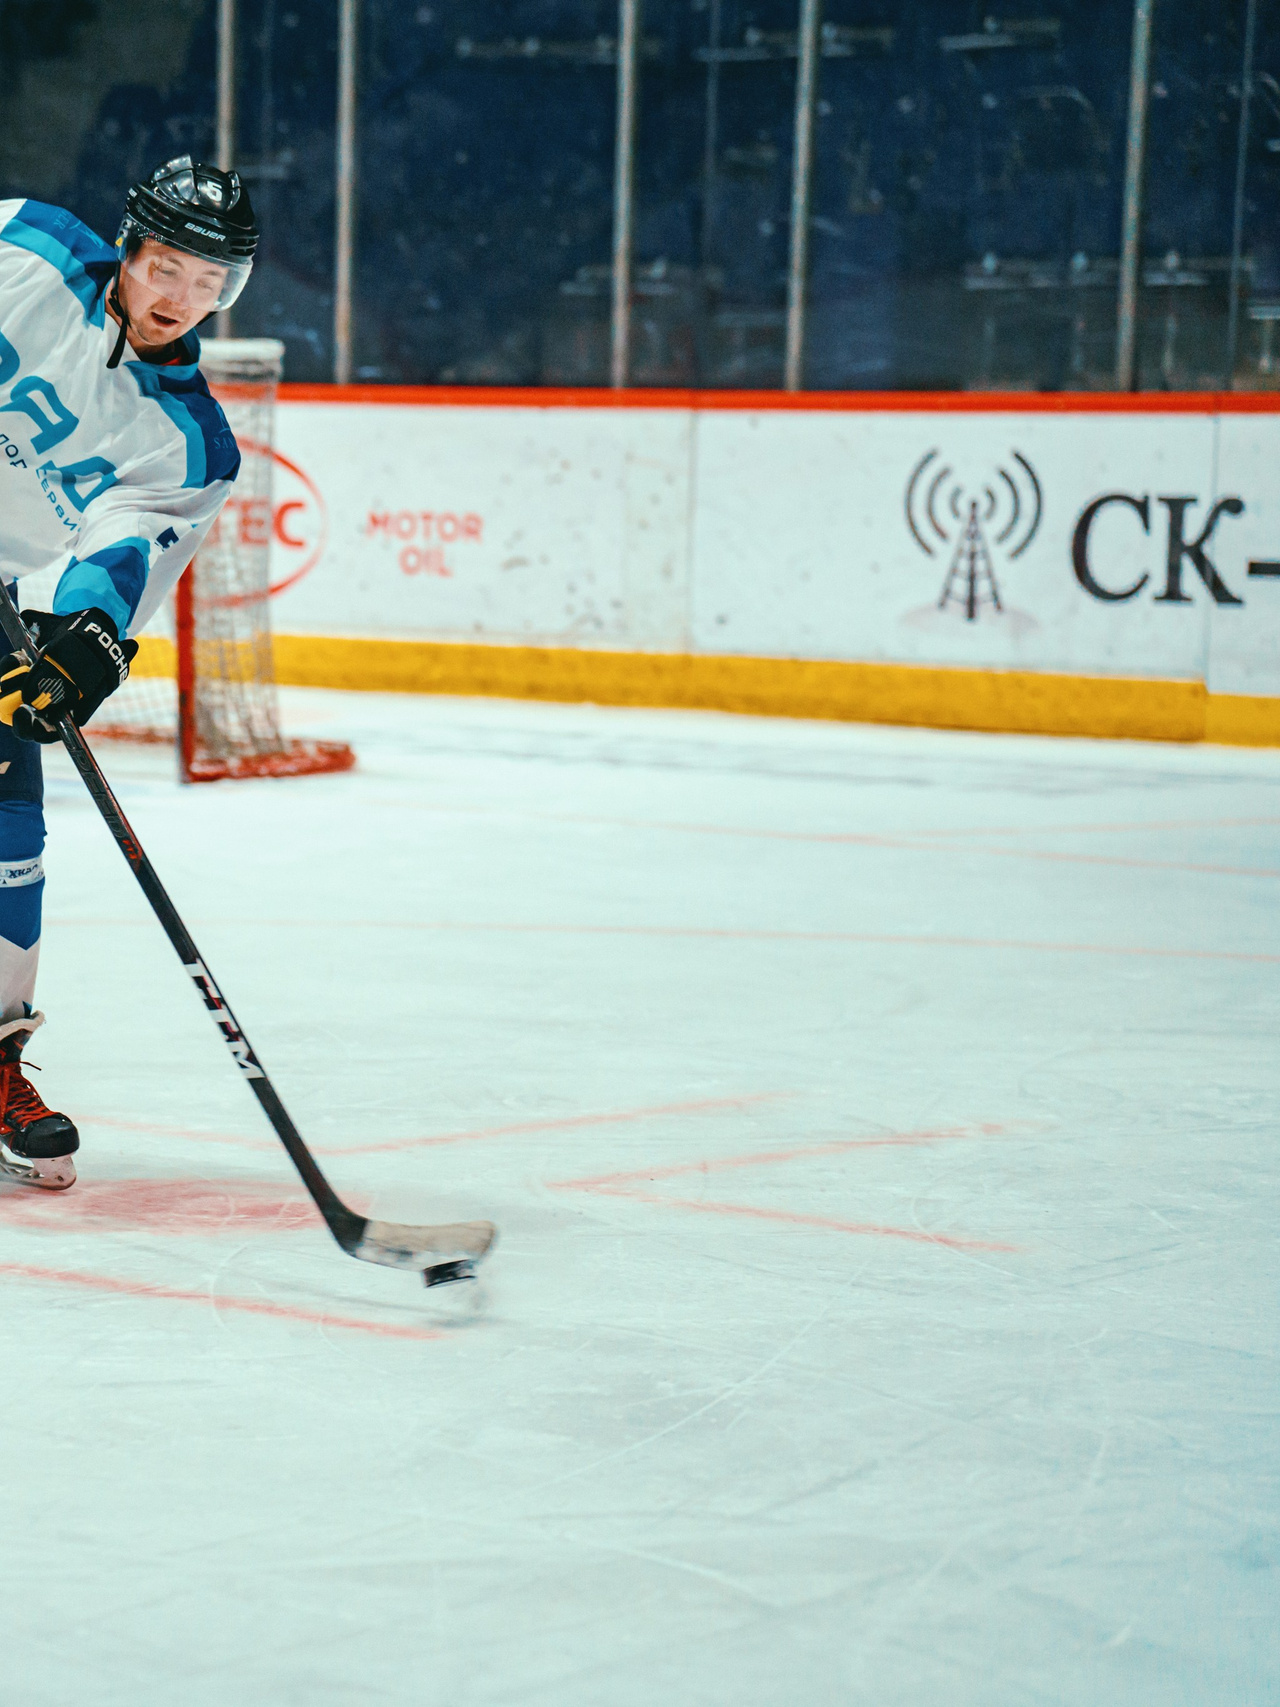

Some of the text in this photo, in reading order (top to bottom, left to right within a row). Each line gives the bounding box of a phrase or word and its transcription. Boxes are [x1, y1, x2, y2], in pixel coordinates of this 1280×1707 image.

[205, 180, 223, 202] 5
[184, 221, 227, 242] BAUER
[367, 510, 483, 543] MOTOR
[398, 545, 452, 577] OIL
